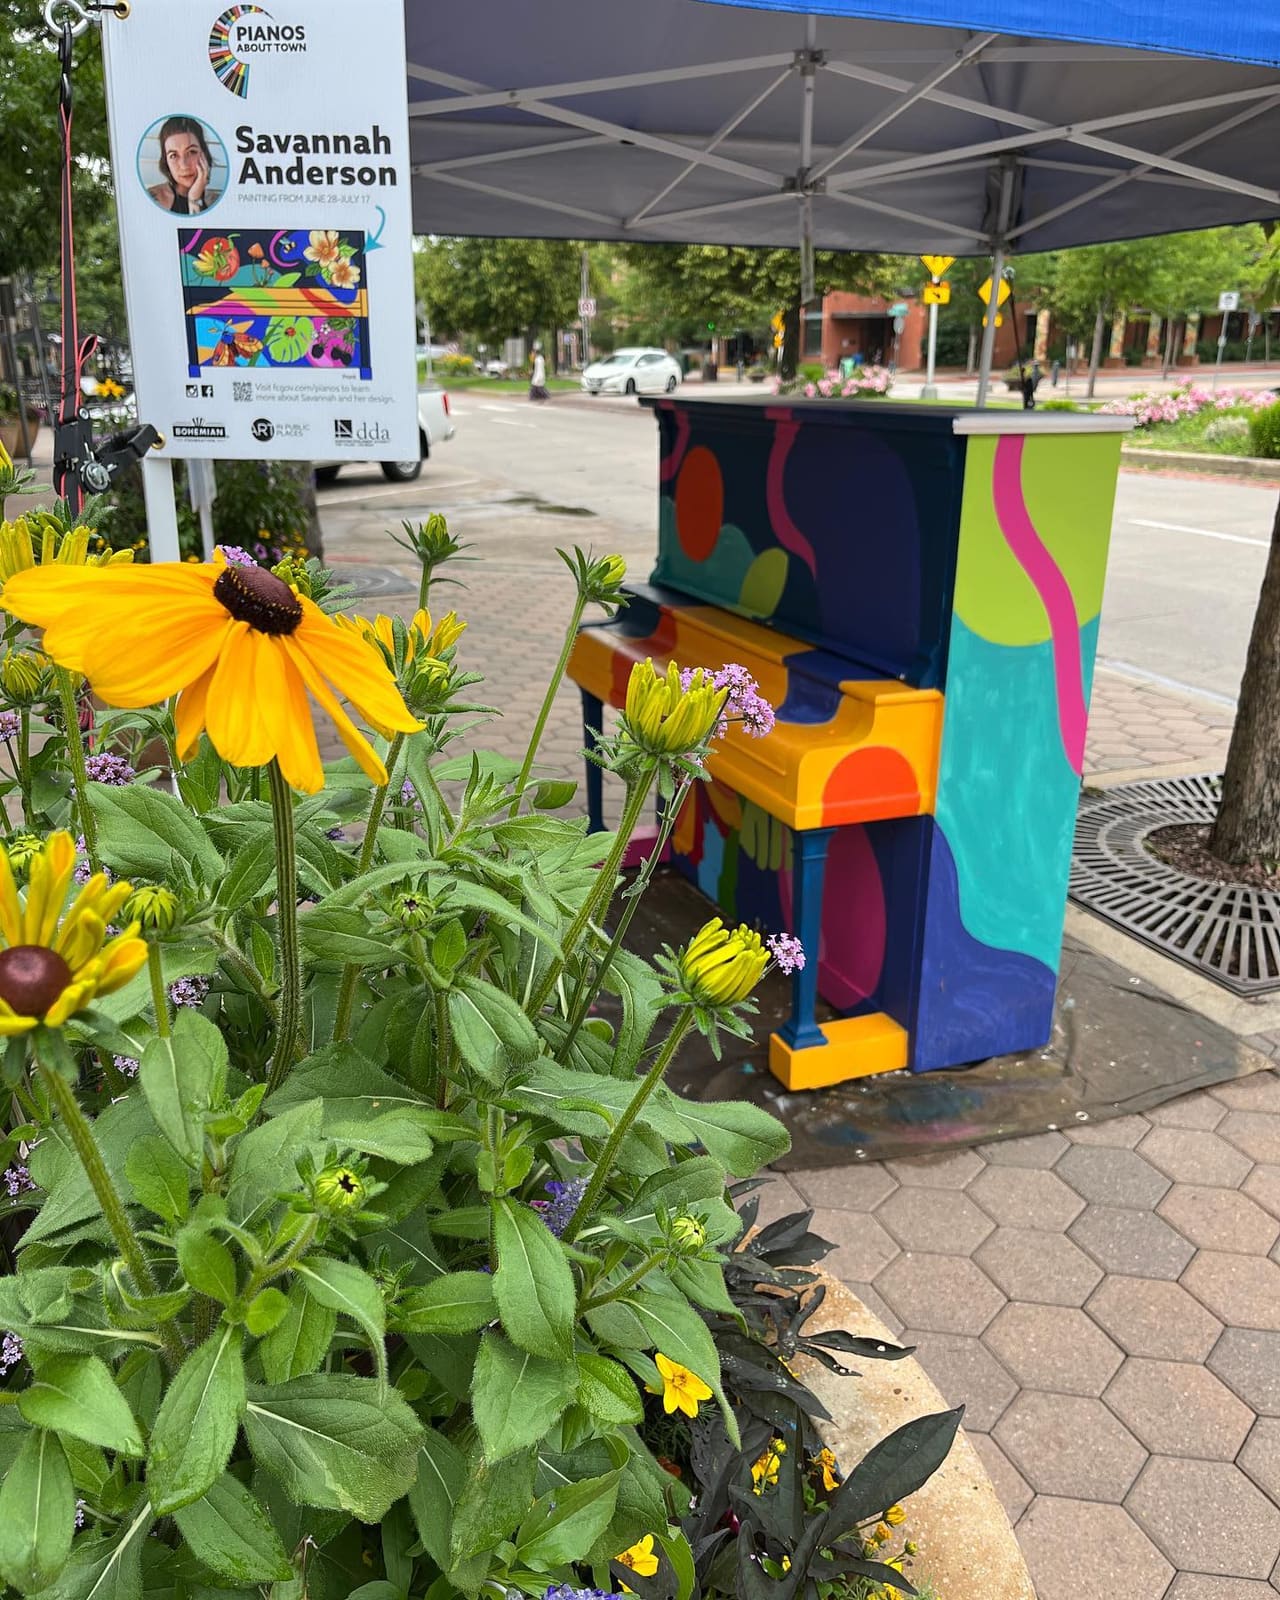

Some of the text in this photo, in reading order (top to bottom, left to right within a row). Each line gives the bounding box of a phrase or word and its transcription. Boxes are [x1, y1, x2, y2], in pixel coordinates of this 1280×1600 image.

[236, 25, 305, 41] PIANOS
[236, 43, 307, 52] ABOUT TOWN
[235, 125, 391, 154] Savannah
[238, 156, 397, 186] Anderson
[238, 194, 278, 203] PAINTING
[279, 194, 303, 203] FROM
[304, 194, 326, 204] JUNE
[255, 383, 271, 392] Visit
[341, 384, 350, 392] to
[351, 383, 370, 392] learn
[278, 393, 299, 402] about
[301, 393, 337, 402] Savannah
[338, 393, 352, 402] and
[354, 393, 367, 402] her
[174, 427, 224, 436] BOHEMIAN
[356, 421, 390, 440] dda
